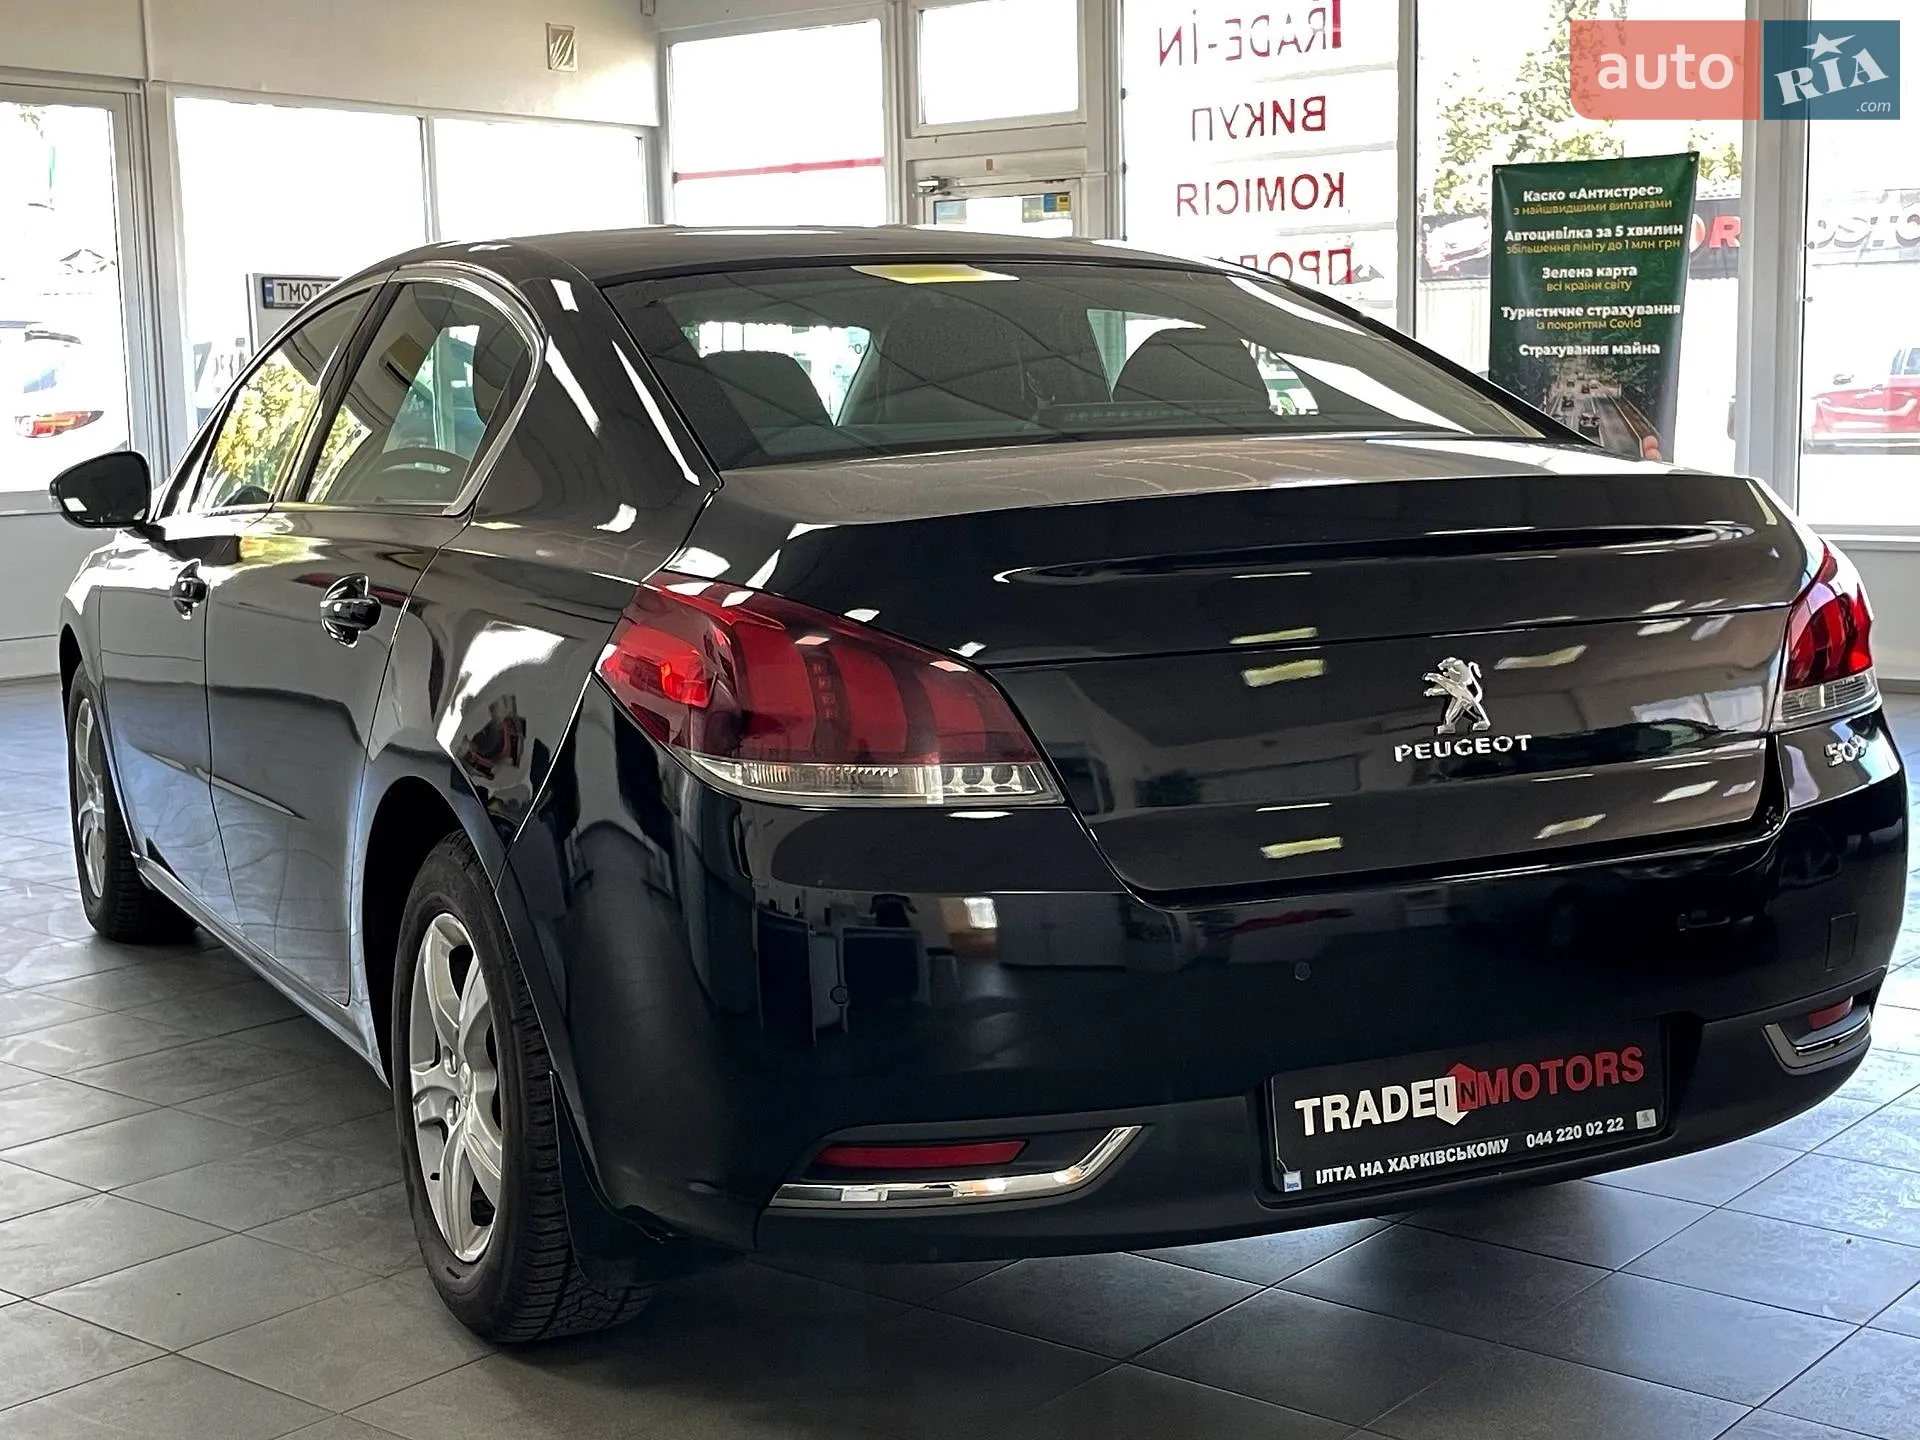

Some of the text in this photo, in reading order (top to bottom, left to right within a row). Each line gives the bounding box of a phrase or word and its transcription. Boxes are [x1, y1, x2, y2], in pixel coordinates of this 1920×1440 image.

[1523, 185, 1664, 202] Каско «Антистрес»
[1608, 199, 1673, 212] виплатами
[1504, 224, 1683, 242] Автоцивілка за 5 хвилин
[1608, 242, 1622, 252] до
[1631, 240, 1656, 249] млн
[1658, 239, 1681, 251] грн
[1542, 265, 1638, 280] Зелена карта
[276, 283, 332, 302] TMOT
[1546, 281, 1563, 292] всі
[1500, 304, 1681, 320] Туристичне страхування
[1609, 318, 1642, 329] Covid
[1519, 341, 1660, 358] Страхування майна
[1394, 734, 1532, 762] PEUGEOT
[1359, 1160, 1385, 1178] НА
[1387, 1138, 1509, 1173] ХАРКІВСЬКОМУ
[1526, 1130, 1553, 1149] 044
[1556, 1125, 1582, 1144] 220
[1585, 1120, 1604, 1138] 02
[1606, 1117, 1624, 1133] 22
